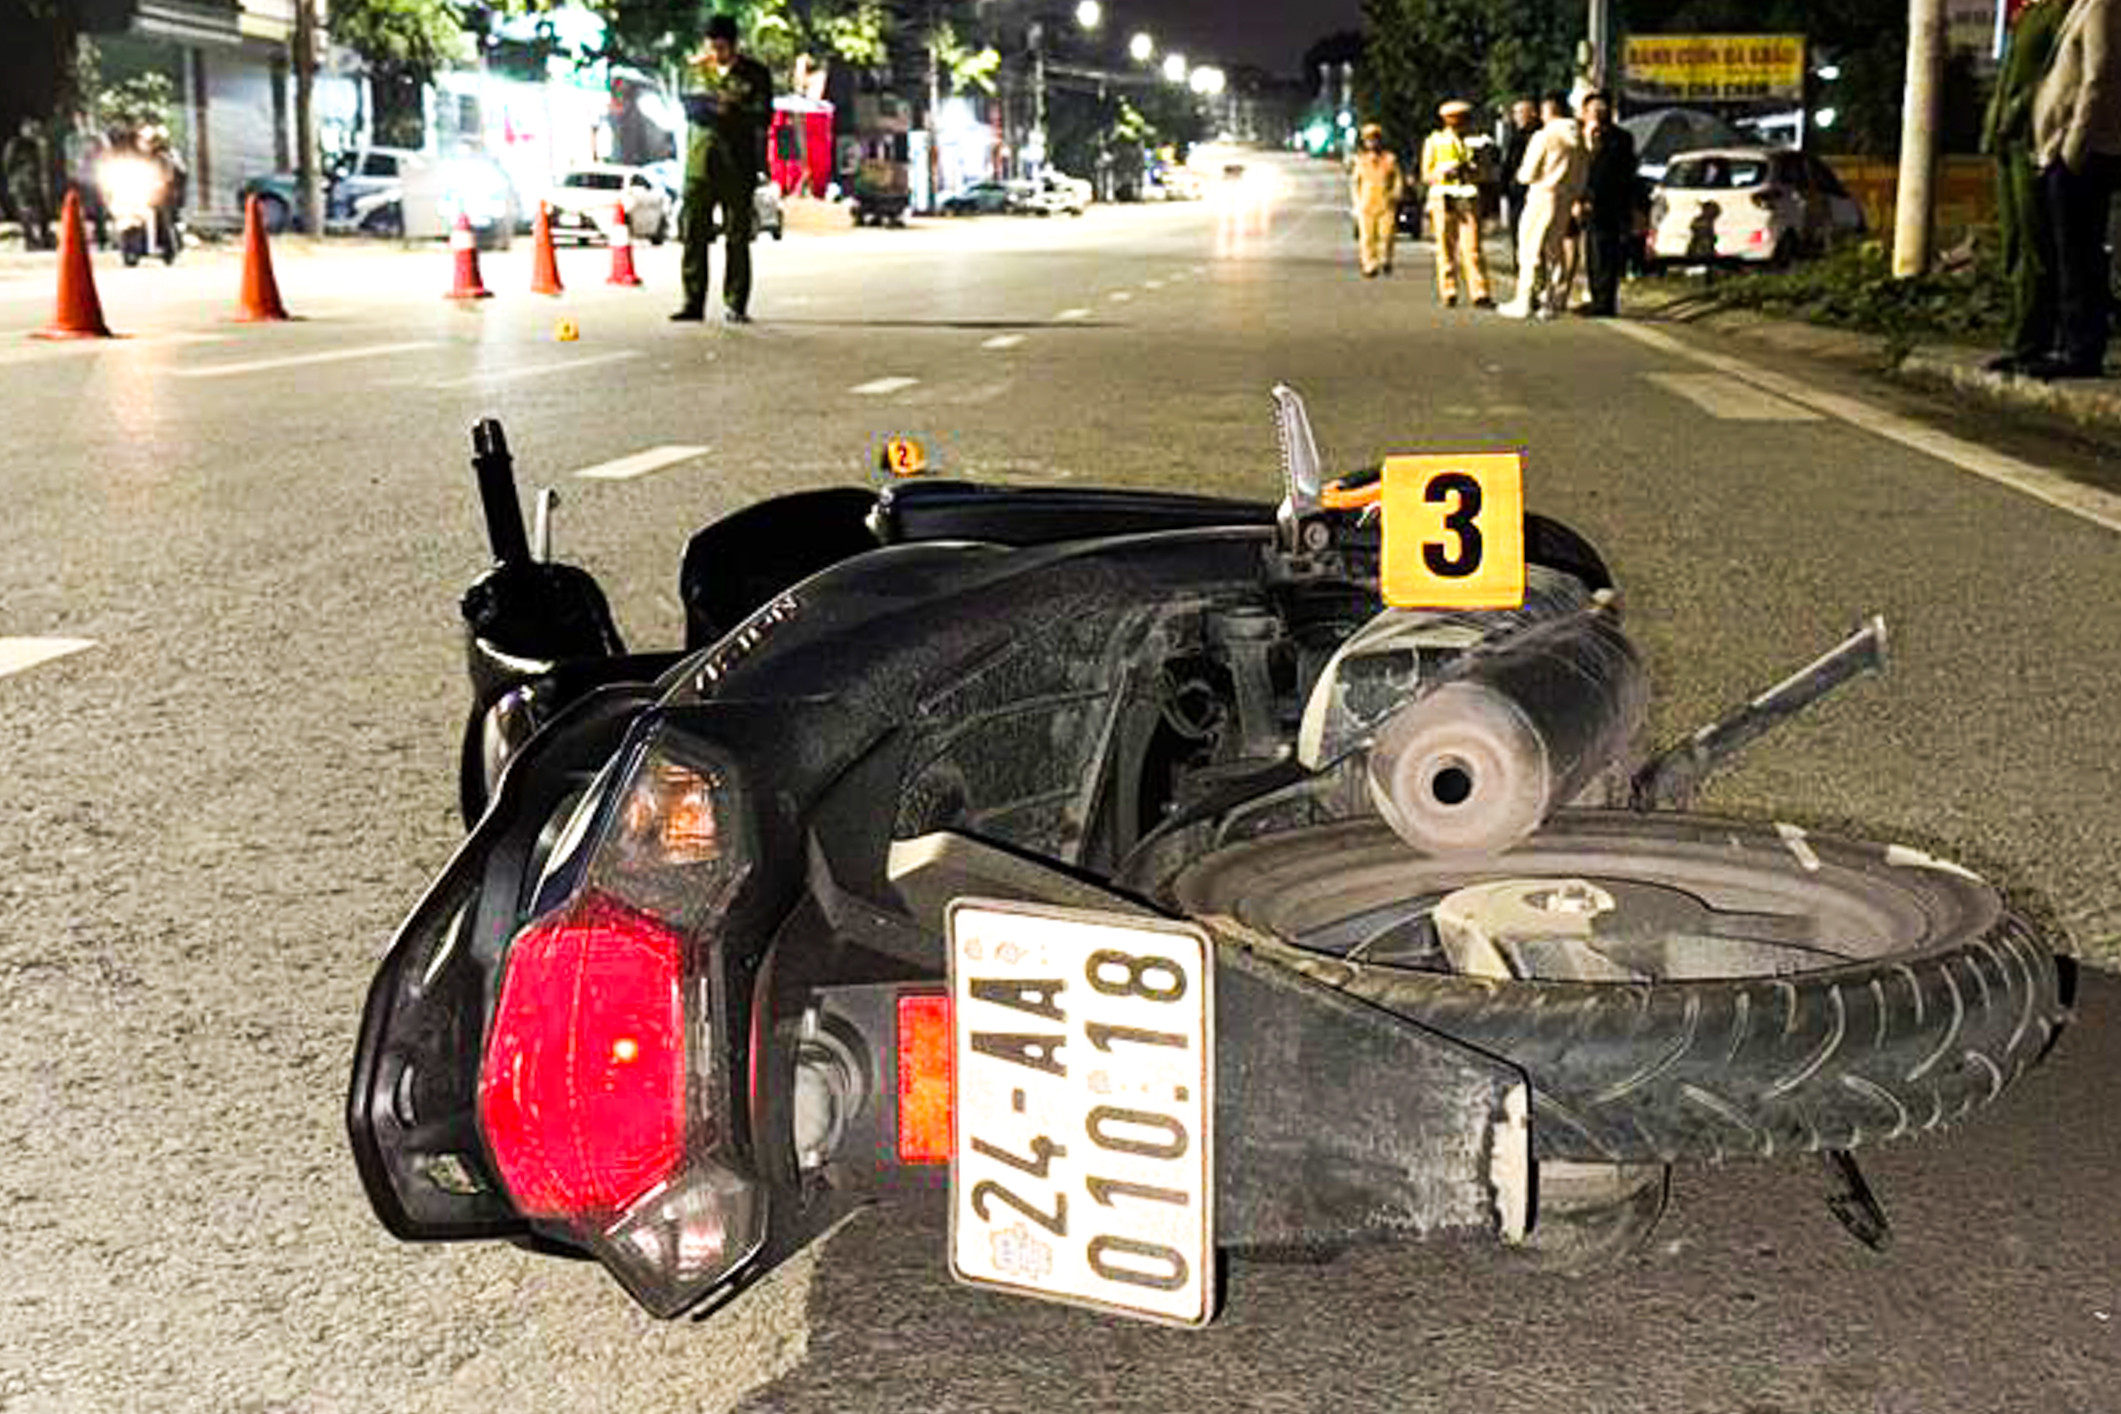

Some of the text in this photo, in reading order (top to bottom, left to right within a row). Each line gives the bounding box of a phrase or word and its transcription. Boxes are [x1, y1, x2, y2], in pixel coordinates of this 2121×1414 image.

[897, 445, 911, 468] 2
[1423, 472, 1483, 578] 3
[969, 977, 1068, 1237] 24-AA
[1084, 948, 1189, 1292] 010.18
